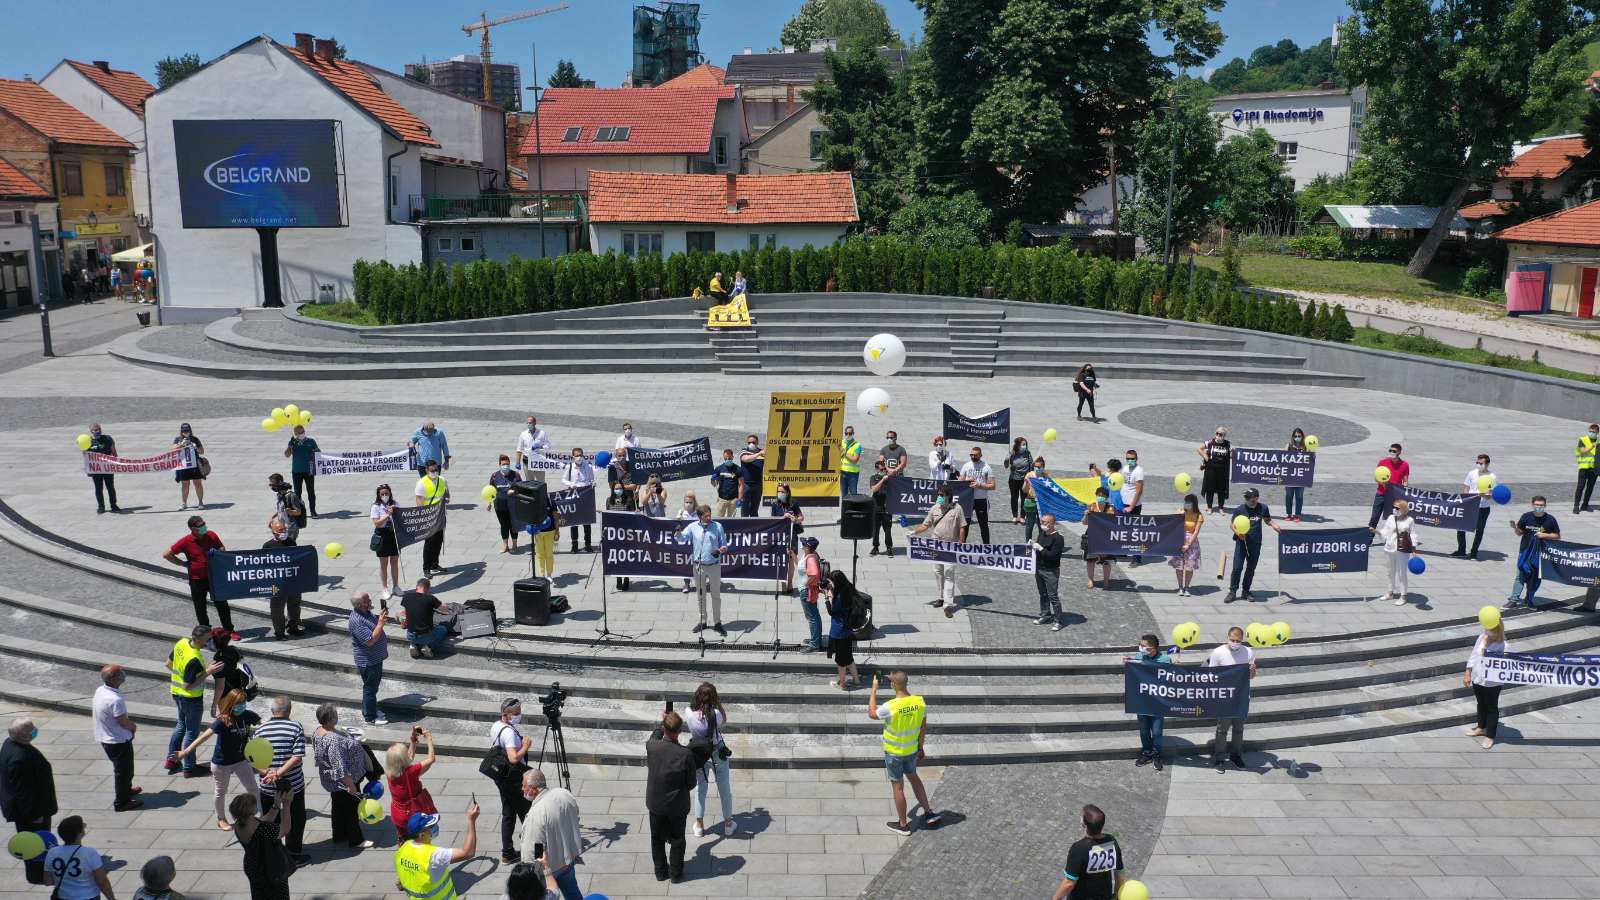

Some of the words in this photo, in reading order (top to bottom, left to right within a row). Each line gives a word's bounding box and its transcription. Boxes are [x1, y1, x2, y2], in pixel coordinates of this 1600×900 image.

[1245, 110, 1260, 121] IPI
[1263, 108, 1324, 121] Akademija
[217, 167, 311, 183] BELGRAND
[231, 215, 297, 225] www.belgrand.net
[771, 397, 794, 405] DOSTA
[317, 458, 361, 467] PLATFORMA
[374, 455, 408, 464] PROGRES
[342, 451, 371, 459] MOSTAR
[373, 450, 383, 458] JE
[635, 460, 662, 470] СНАГА
[663, 454, 709, 469] ПРОМЈЕНЕ
[1236, 451, 1241, 461] I
[1243, 452, 1278, 463] TUZLA
[1281, 452, 1311, 464] KAŽE
[89, 463, 102, 473] NA
[153, 458, 184, 471] GRADA
[321, 466, 347, 475] BOSNE
[353, 463, 404, 473] HERCEGOVINE
[530, 461, 561, 470] IZBORE
[565, 489, 580, 501] ZA
[900, 493, 916, 503] ZA
[1404, 487, 1444, 502] TUZLA
[1447, 493, 1464, 504] ZA
[1408, 499, 1465, 518] OŠTENJE
[1116, 515, 1157, 527] TUZLA
[607, 526, 652, 544] DOSTA
[655, 530, 672, 545] JE
[1110, 530, 1128, 541] NE
[1131, 528, 1161, 543] ŠUTI
[910, 536, 1012, 556] ELEKTRONSKO
[1312, 541, 1351, 553] IZBORI
[1354, 543, 1367, 552] se
[235, 553, 291, 567] Prioritet:
[607, 548, 652, 565] ДОСТА
[655, 551, 672, 564] ЈЕ
[959, 554, 1032, 571] GLASANJE
[227, 566, 300, 582] INTEGRITET
[1484, 659, 1555, 673] JEDINSTVEN
[1157, 668, 1219, 683] Prioritet:
[1484, 670, 1488, 679] I
[1499, 672, 1554, 685] CJELOVIT
[1557, 665, 1600, 687] MOS
[1139, 683, 1236, 700] PROSPERITET
[898, 704, 919, 714] REDAR
[52, 857, 82, 878] 93
[400, 858, 419, 872] REDAR
[1089, 848, 1115, 872] 225
